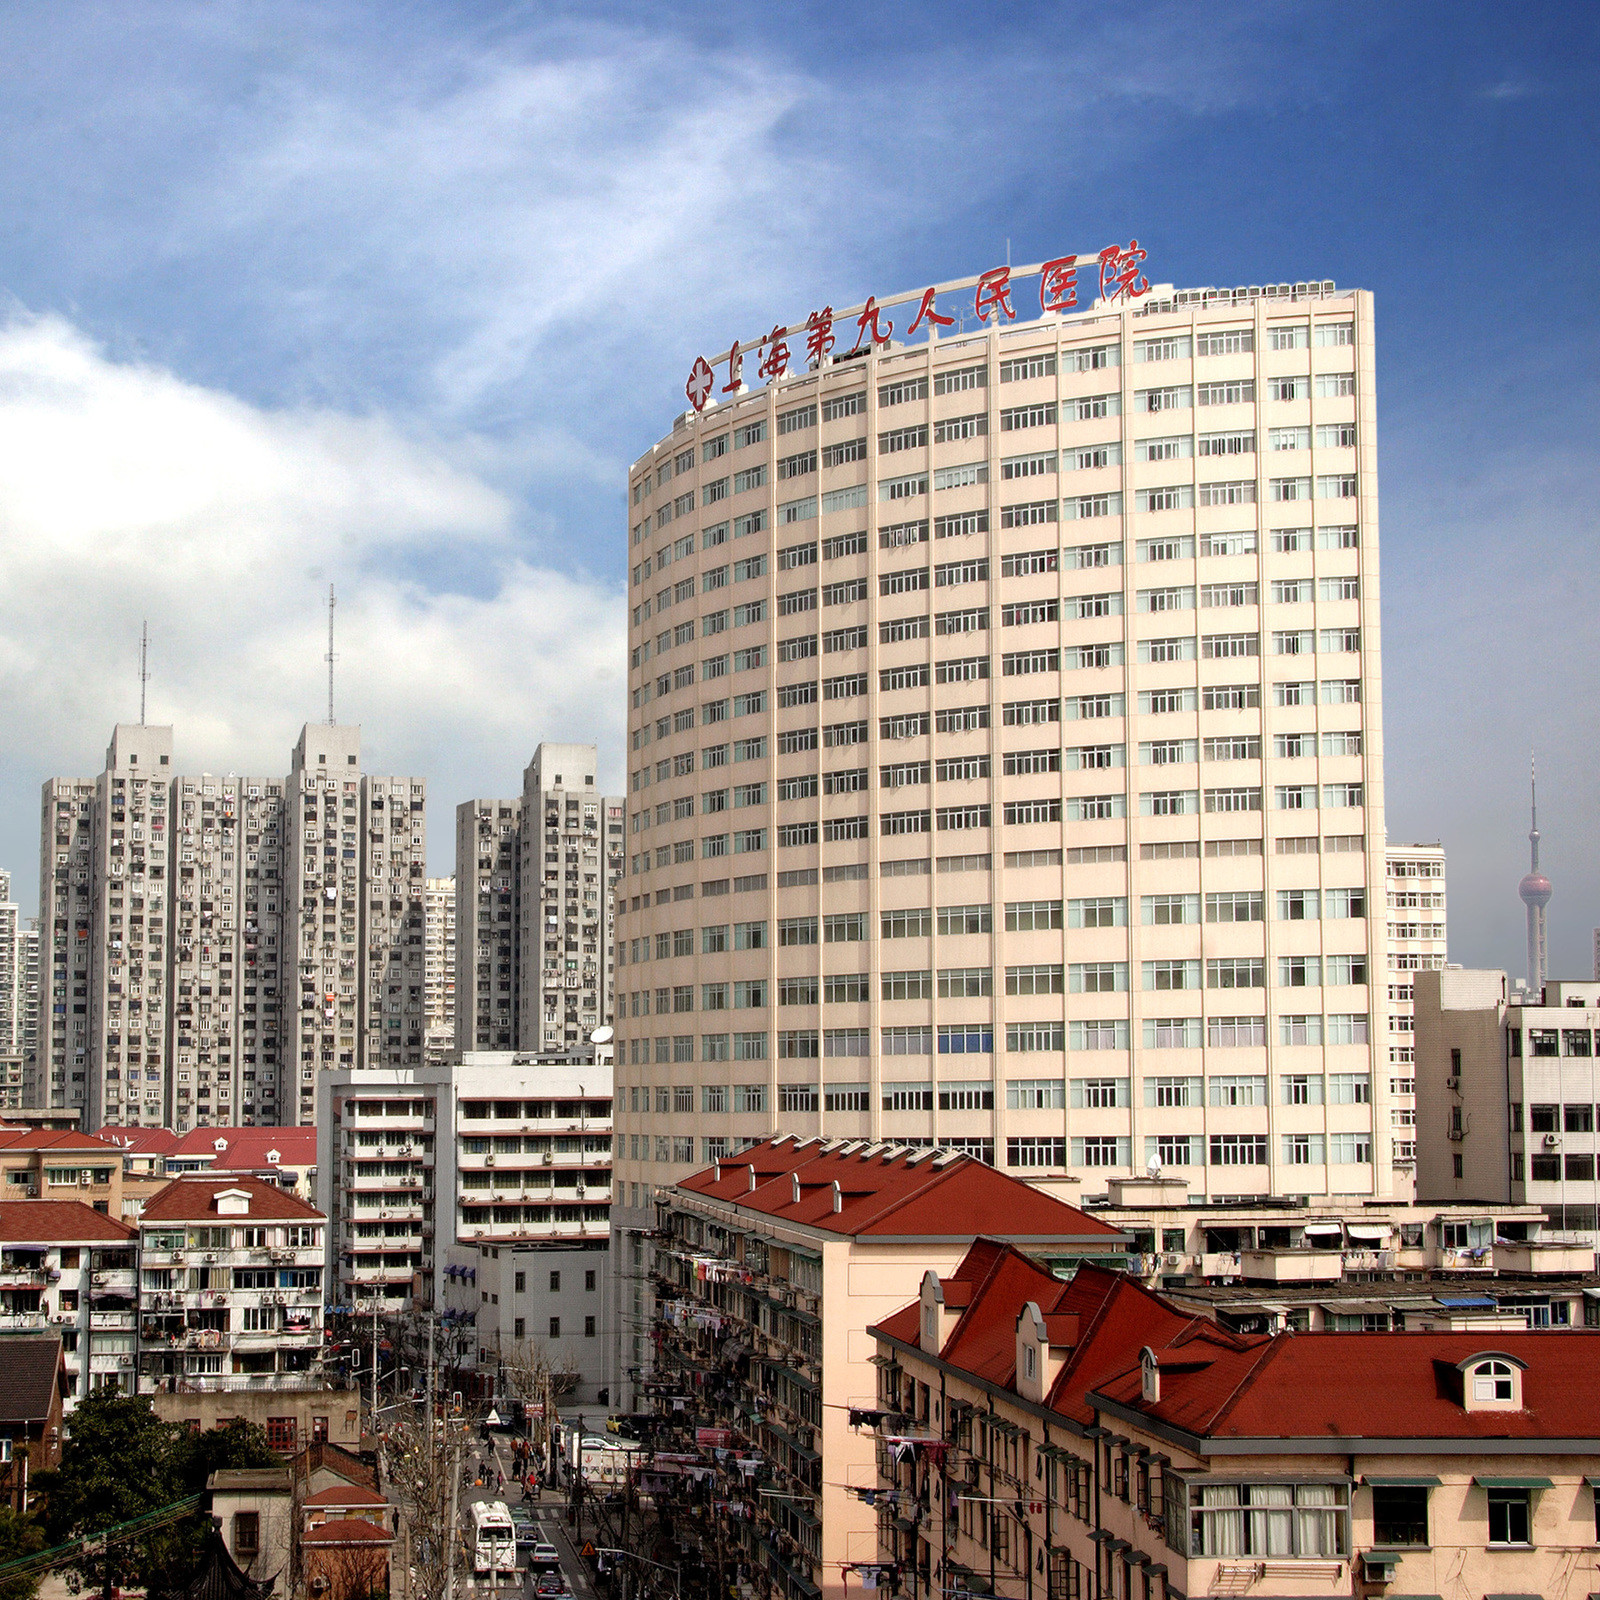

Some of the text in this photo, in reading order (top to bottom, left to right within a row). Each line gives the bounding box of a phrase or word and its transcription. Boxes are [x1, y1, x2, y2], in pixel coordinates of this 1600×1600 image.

[721, 240, 1148, 393] 上海第九人民医院
